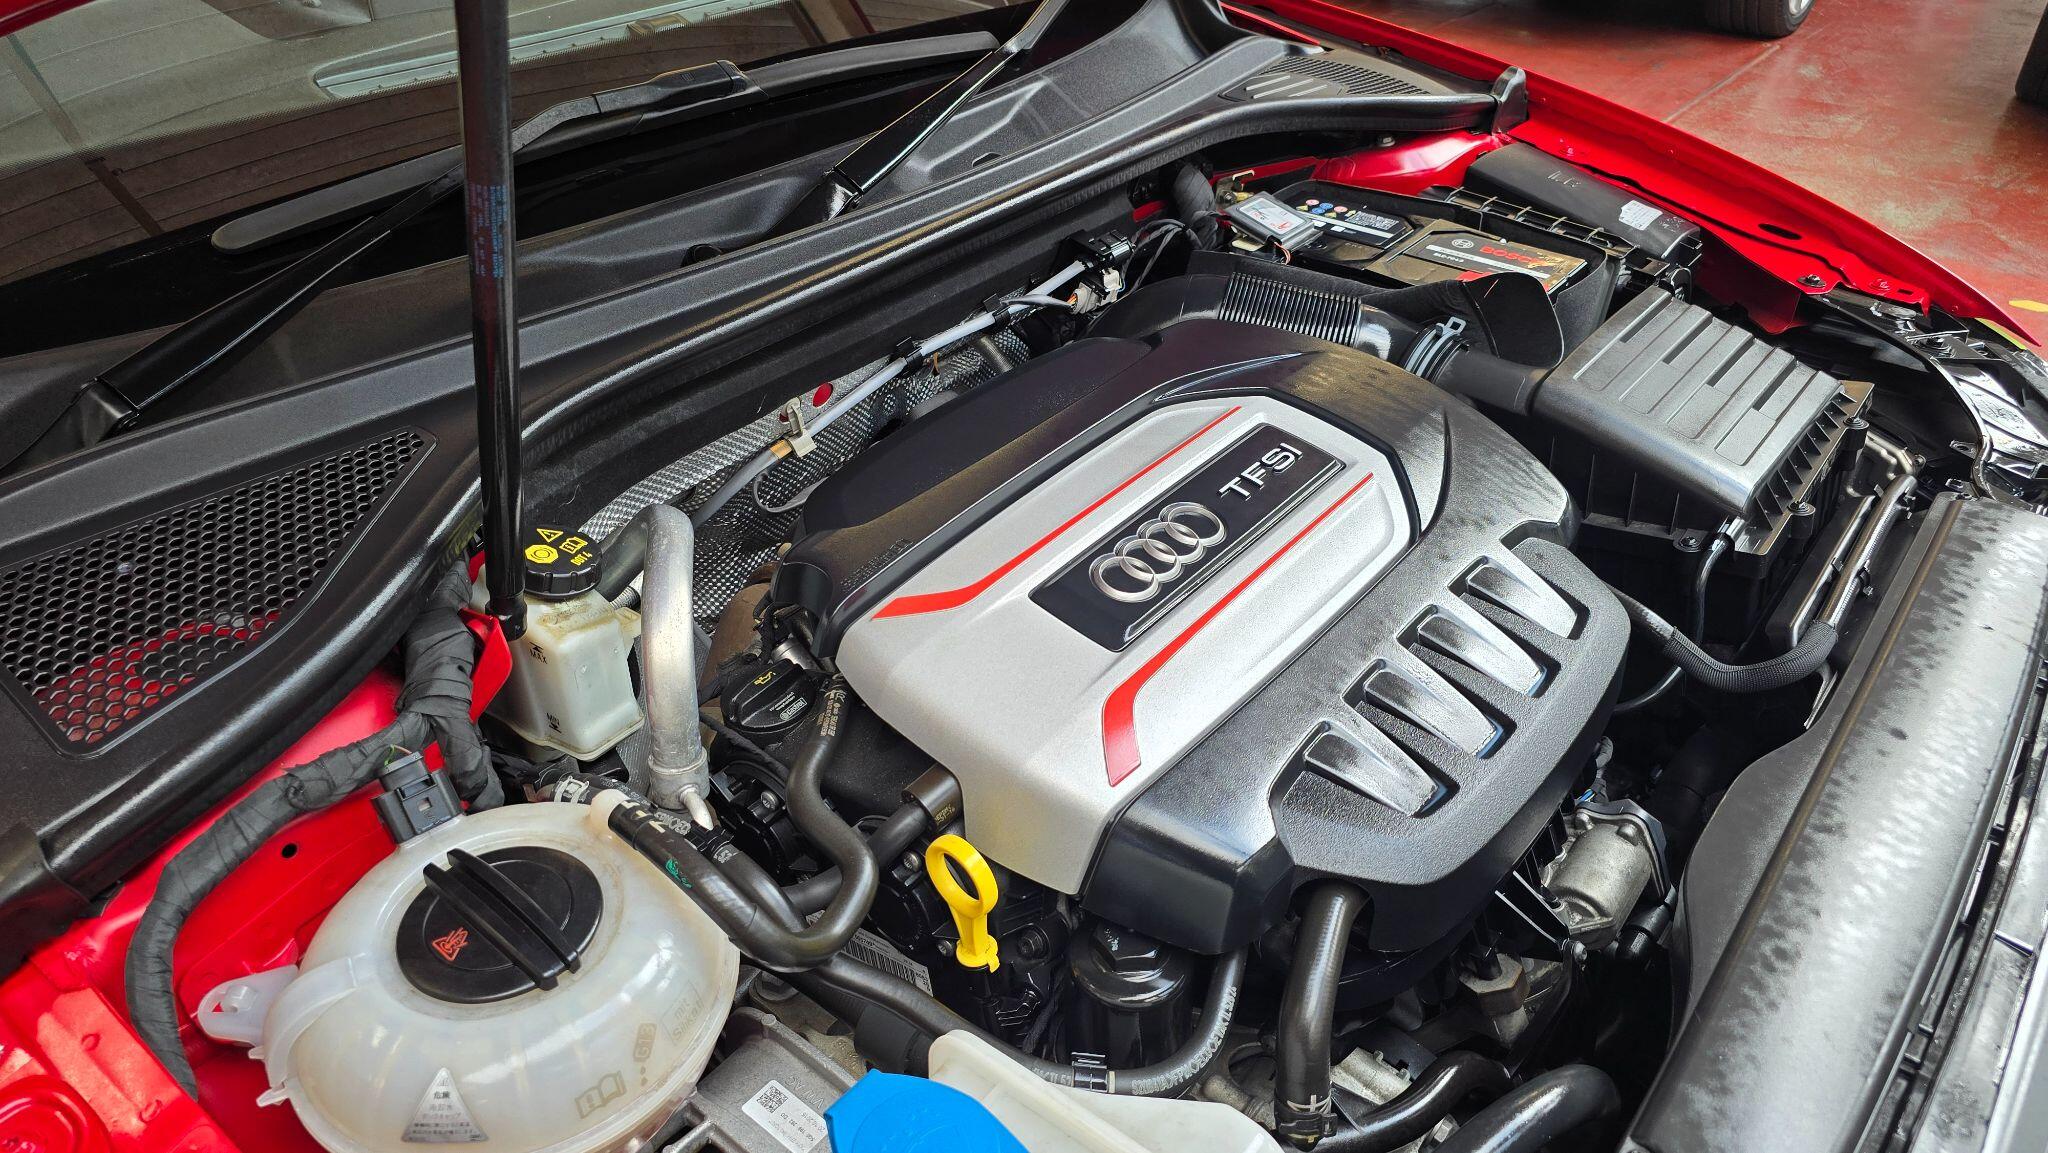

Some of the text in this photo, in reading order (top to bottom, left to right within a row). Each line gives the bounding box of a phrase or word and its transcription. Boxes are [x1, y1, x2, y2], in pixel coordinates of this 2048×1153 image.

[1218, 442, 1303, 500] TFSI
[529, 648, 548, 664] MAX
[786, 700, 804, 716] Castrol
[546, 712, 560, 726] MIN
[674, 998, 690, 1020] mit
[635, 1025, 655, 1058] G13
